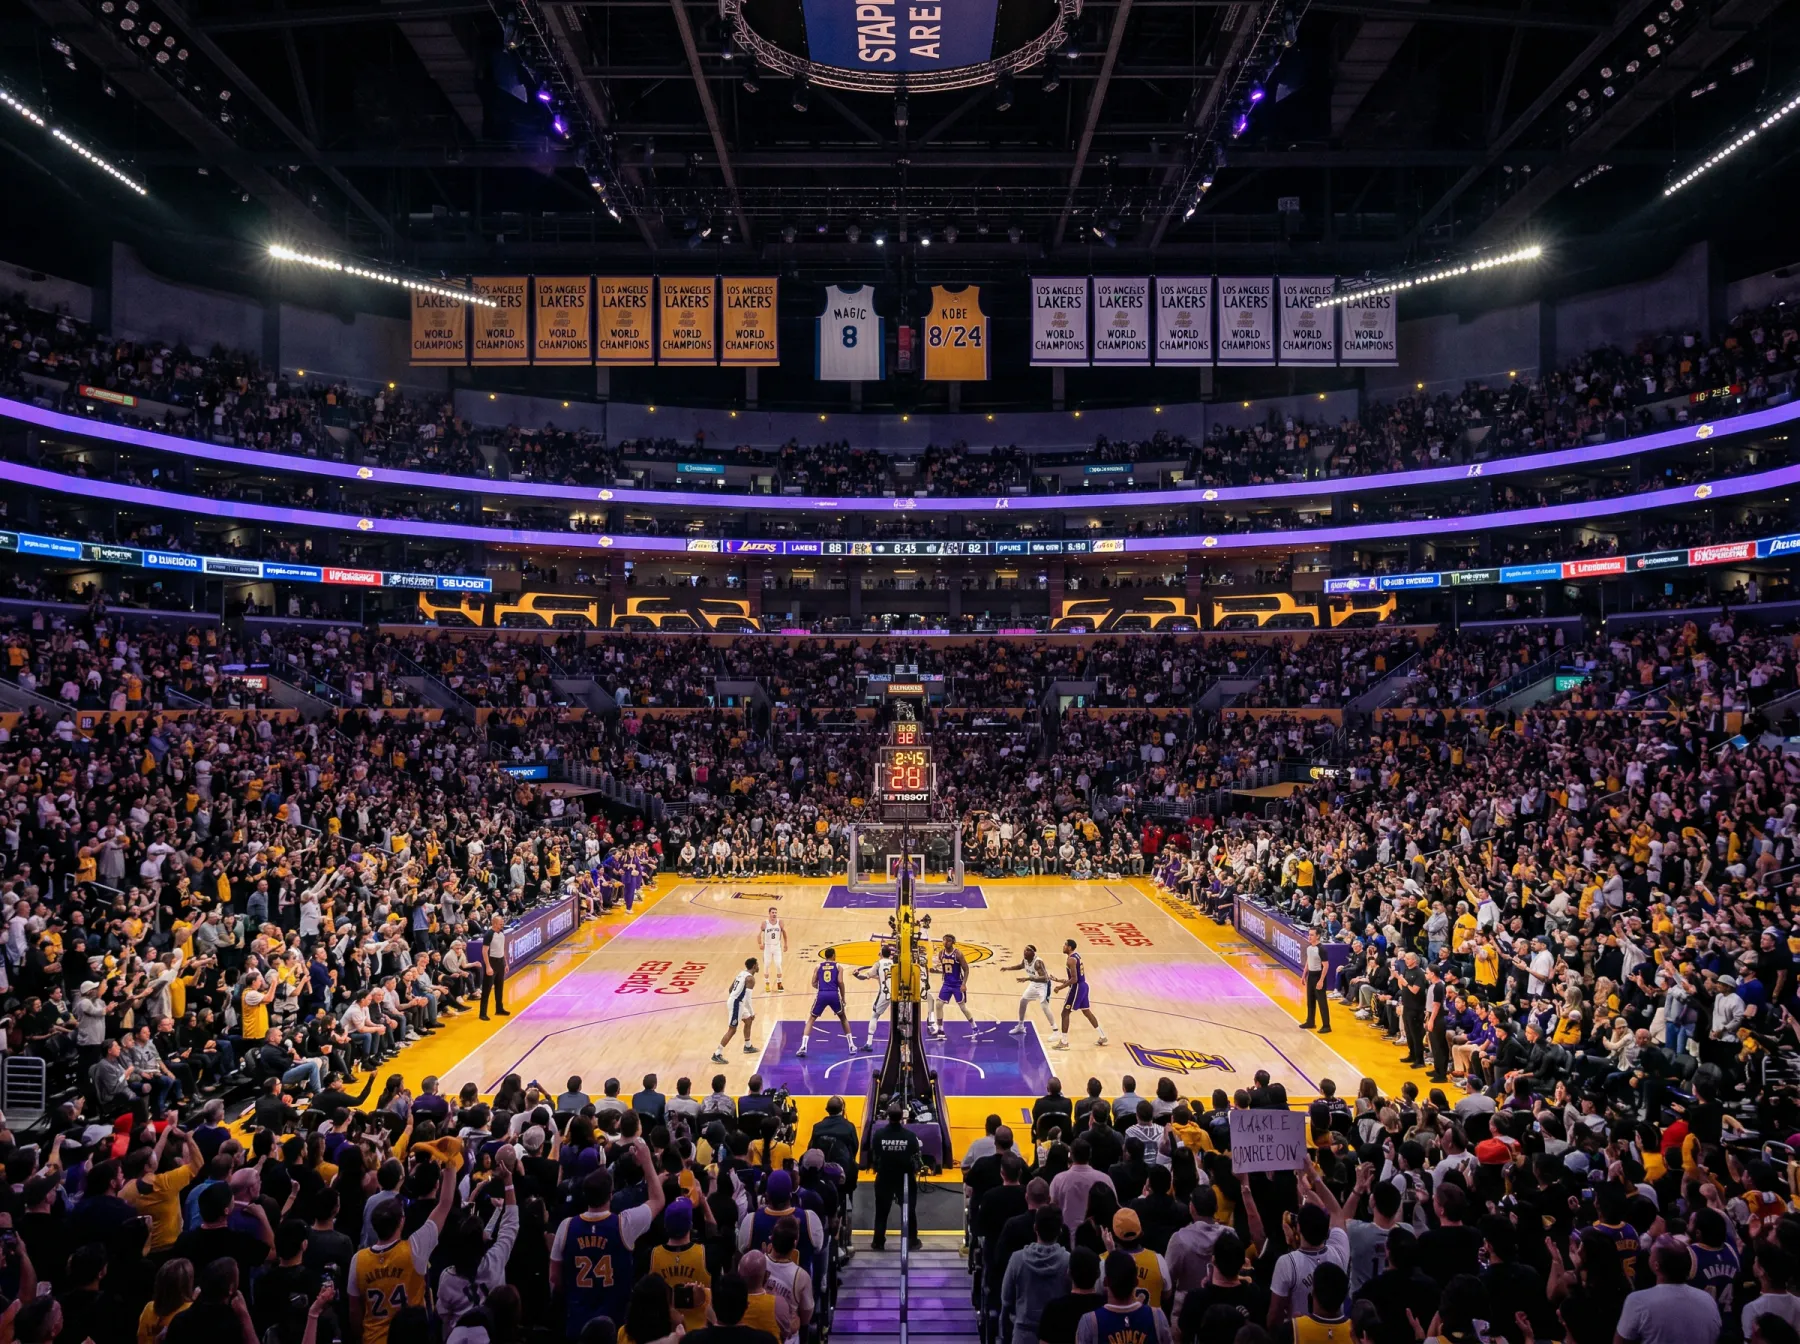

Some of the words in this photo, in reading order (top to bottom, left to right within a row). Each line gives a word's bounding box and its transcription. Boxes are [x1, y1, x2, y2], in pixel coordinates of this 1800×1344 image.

[909, 0, 942, 60] ARE
[540, 285, 552, 294] LOS
[601, 285, 614, 294] LOS
[664, 286, 677, 294] LOS
[726, 286, 740, 295] LOS
[1036, 286, 1050, 295] LOS
[1098, 286, 1112, 295] LOS
[1160, 286, 1174, 295] LOS
[1222, 286, 1236, 295] LOS
[1284, 286, 1296, 295] LOS
[540, 295, 584, 308] LAKERS
[602, 295, 647, 308] LAKERS
[665, 296, 709, 308] LAKERS
[728, 296, 772, 308] LAKERS
[1038, 296, 1082, 309] LAKERS
[1100, 296, 1143, 309] LAKERS
[1162, 296, 1206, 308] LAKERS
[1224, 296, 1268, 308] LAKERS
[833, 307, 867, 320] MAGIC
[942, 308, 968, 320] KOBE
[424, 330, 454, 338] WORLD
[486, 329, 515, 338] WORLD
[610, 329, 640, 338] WORLD
[673, 330, 702, 338] WORLD
[736, 330, 764, 338] WORLD
[842, 325, 858, 348] 8
[929, 326, 982, 348] 8/24
[1046, 330, 1074, 339] WORLD
[1107, 330, 1136, 339] WORLD
[1170, 330, 1199, 339] WORLD
[1232, 330, 1260, 339] WORLD
[1293, 330, 1322, 339] WORLD
[1354, 330, 1384, 339] WORLD
[414, 340, 464, 350] CHAMPIONS
[476, 340, 525, 349] CHAMPIONS
[662, 340, 712, 350] CHAMPIONS
[1035, 341, 1084, 350] CHAMPIONS
[1096, 341, 1146, 350] CHAMPIONS
[1160, 341, 1209, 350] CHAMPIONS
[1222, 341, 1271, 350] CHAMPIONS
[1283, 341, 1332, 350] CHAMPIONS
[1344, 341, 1394, 350] CHAMPIONS
[791, 544, 818, 552] LAKERS
[968, 544, 982, 554] 82
[894, 793, 929, 801] TISSOT
[654, 960, 709, 995] Center
[574, 1254, 614, 1288] 24
[366, 1282, 409, 1318] 24
